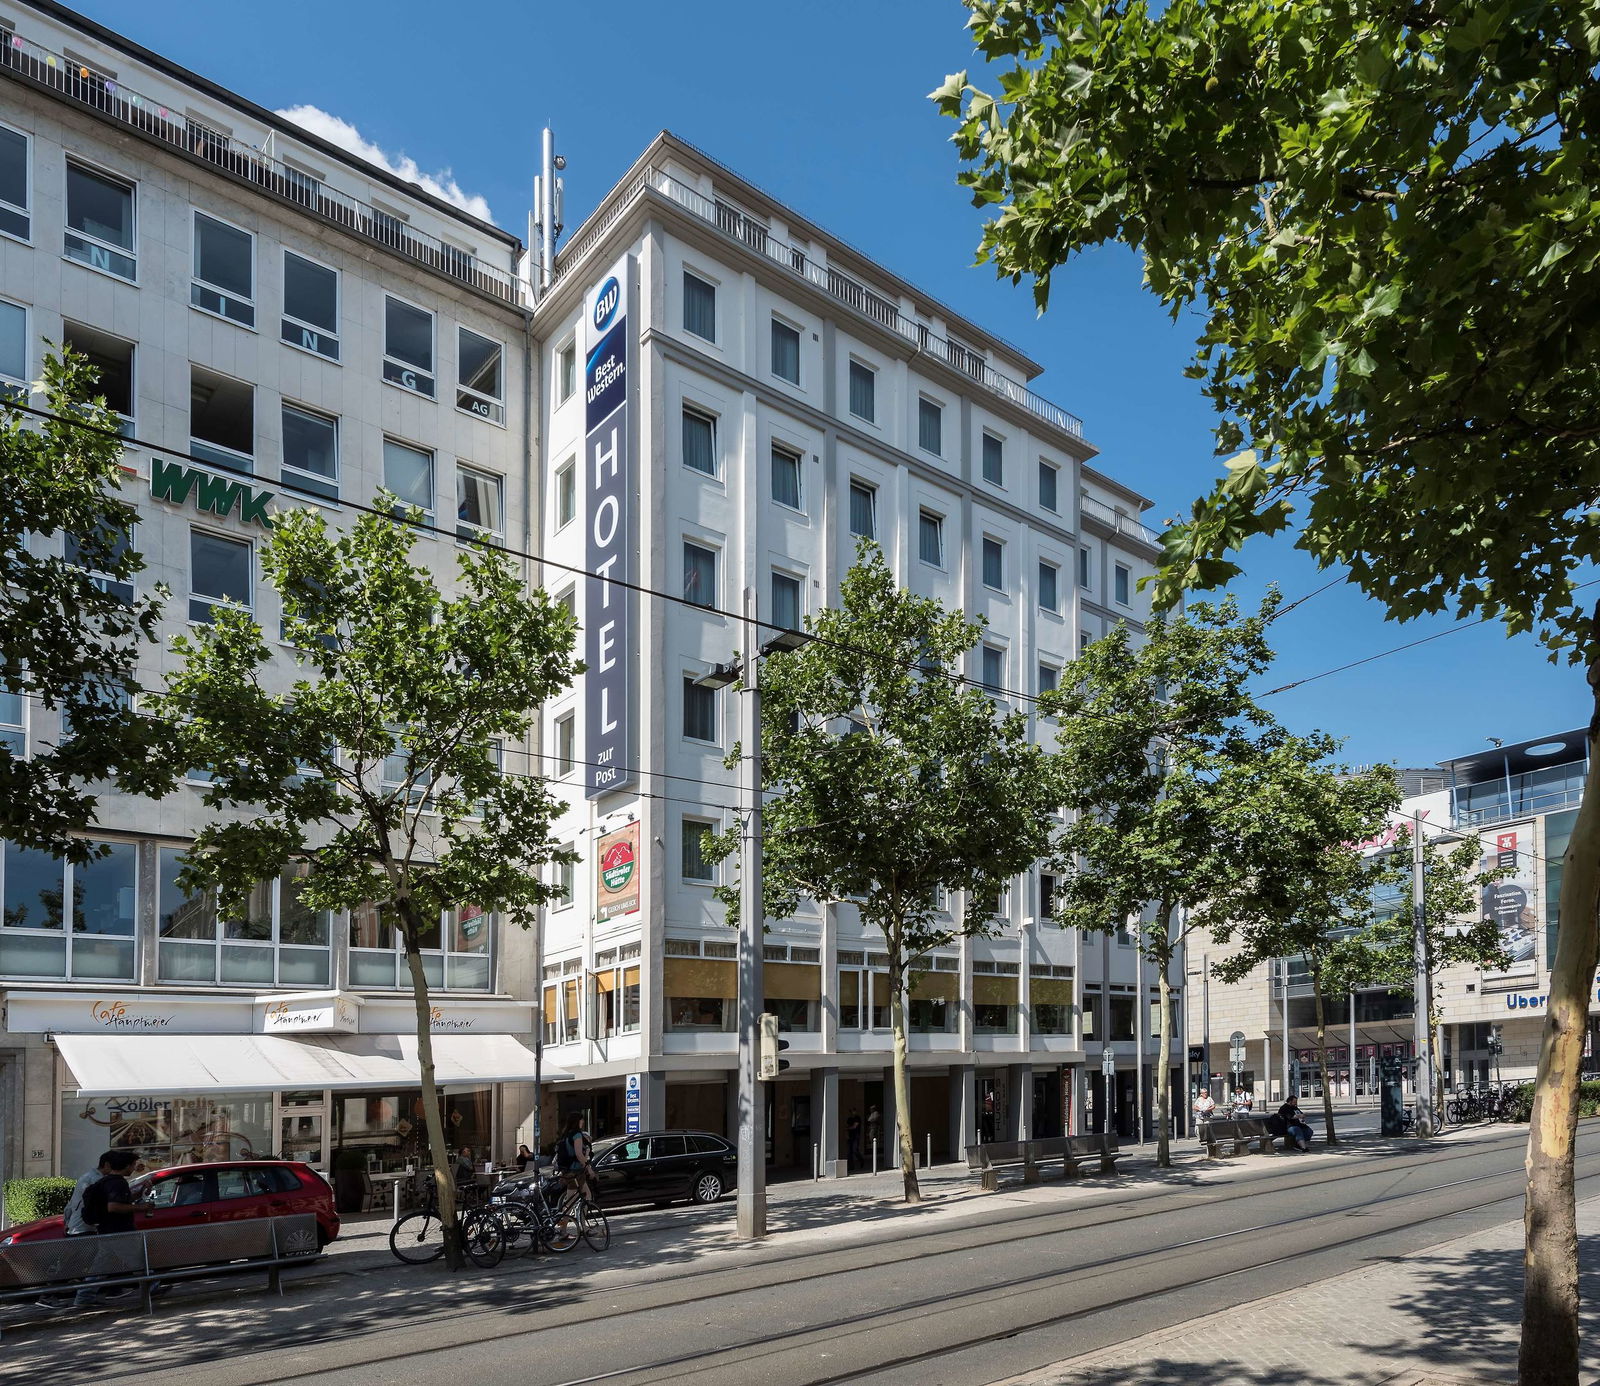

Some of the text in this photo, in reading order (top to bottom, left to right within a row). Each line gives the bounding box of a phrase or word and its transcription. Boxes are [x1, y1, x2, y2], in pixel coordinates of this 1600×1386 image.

[596, 285, 618, 324] BW
[302, 329, 318, 351] N
[401, 370, 416, 390] G
[472, 401, 488, 415] AG
[595, 354, 616, 383] Best
[150, 457, 276, 529] WWK
[594, 427, 619, 736] HOTEL
[598, 747, 614, 765] zur
[596, 766, 617, 787] Post
[1506, 993, 1549, 1010] Über
